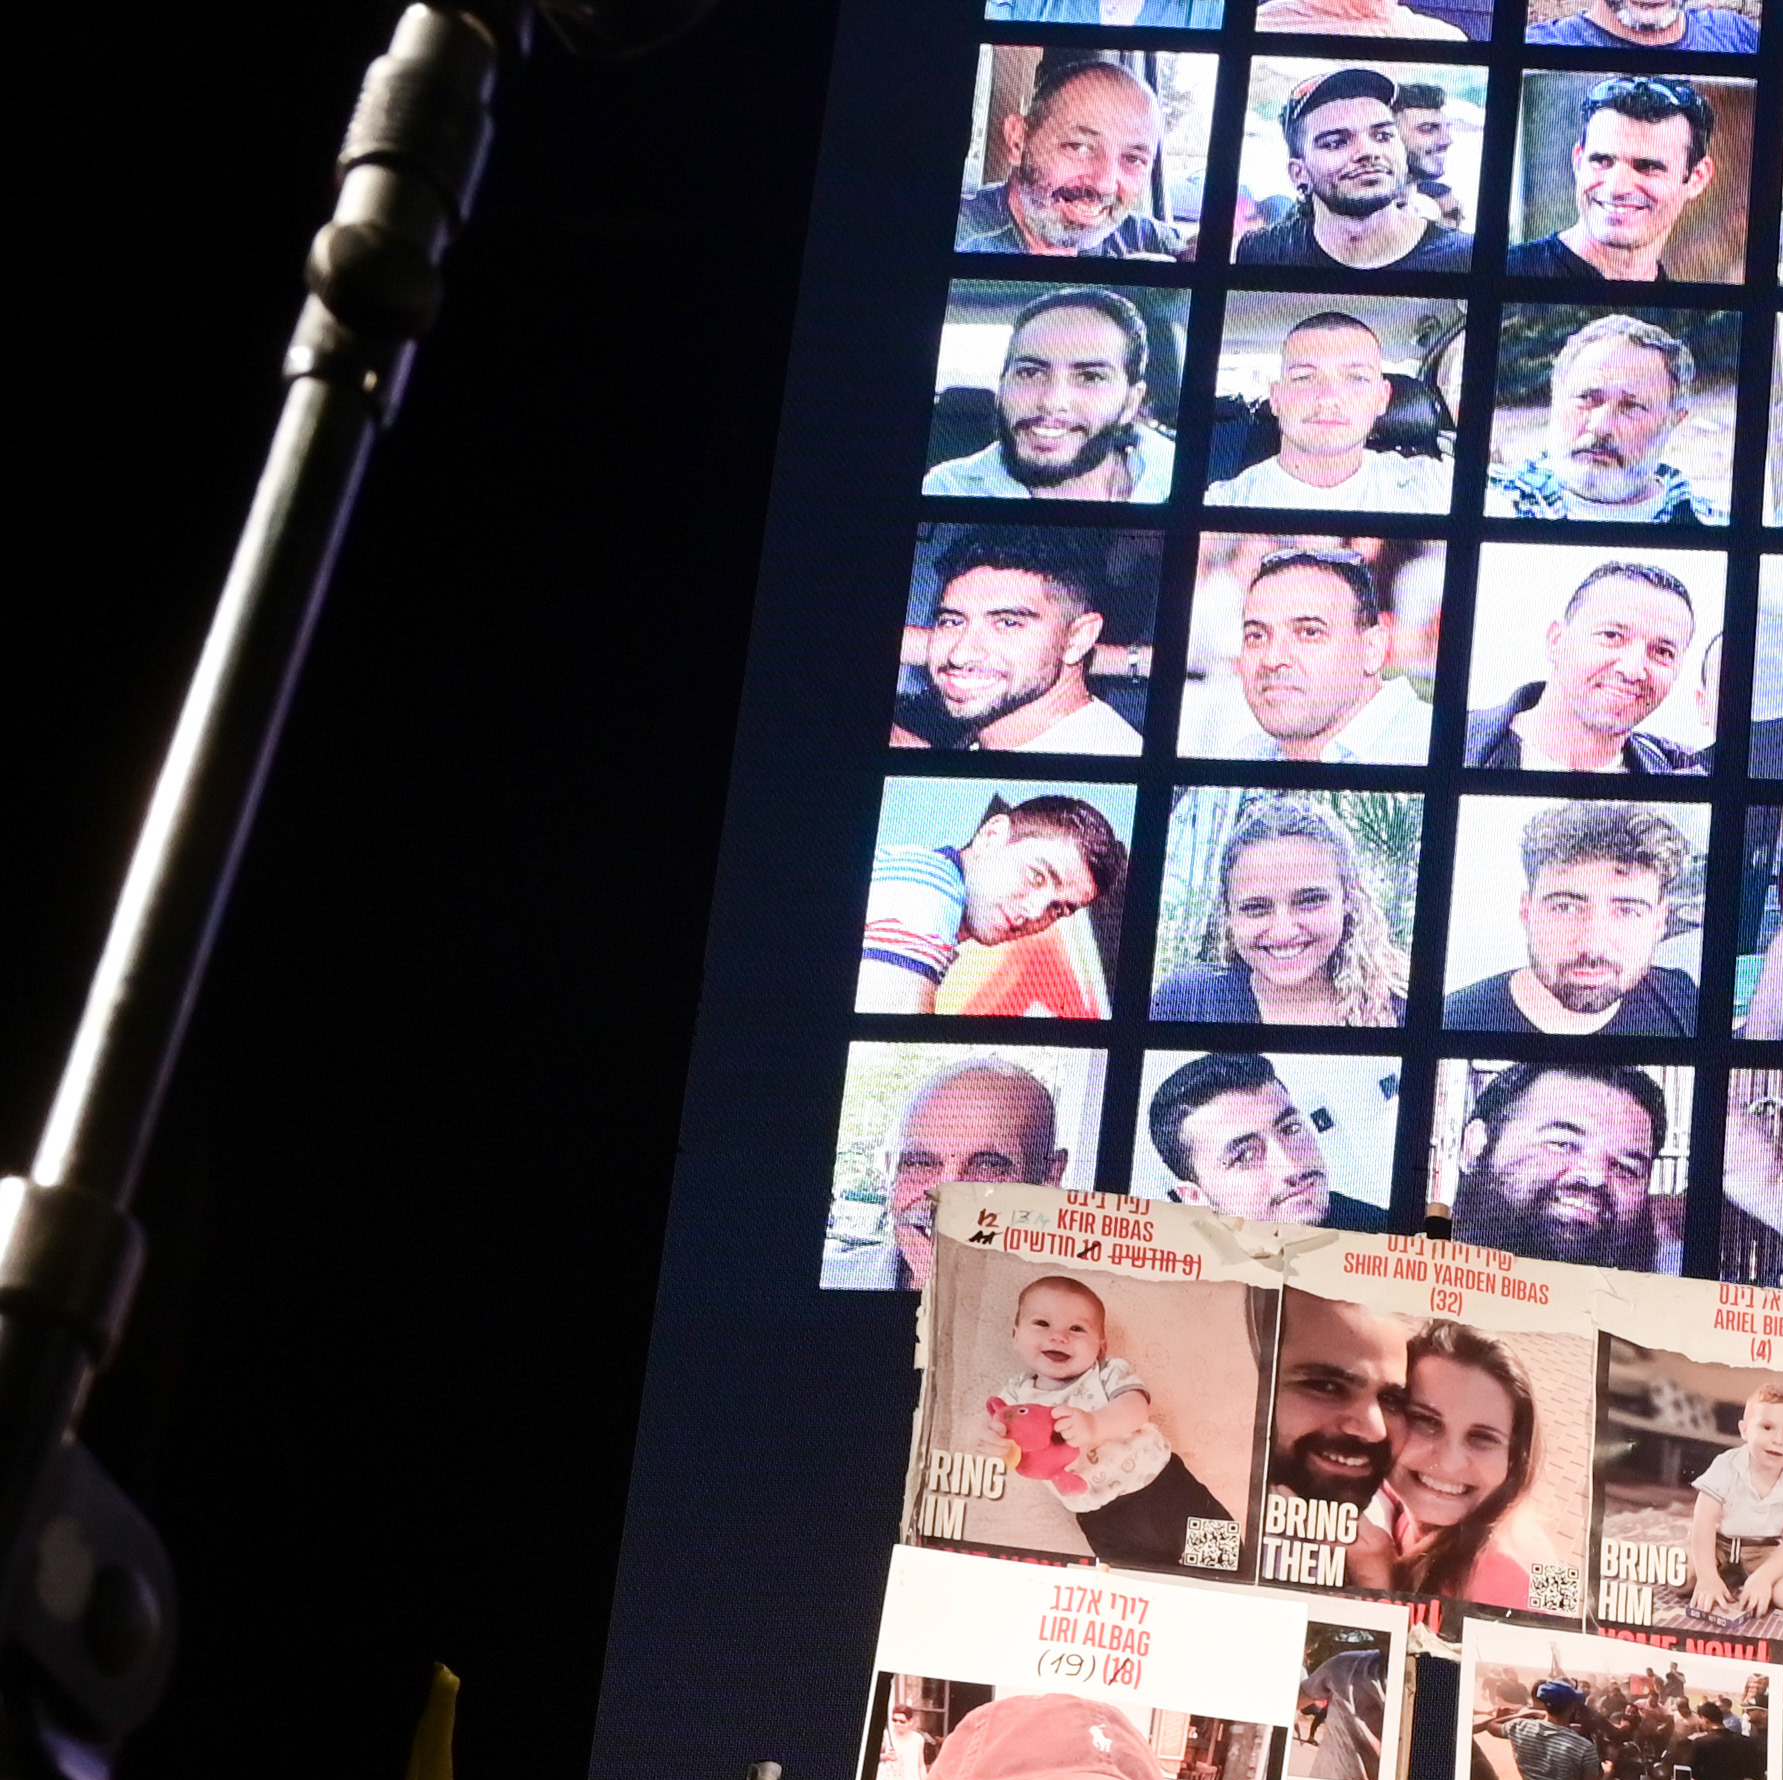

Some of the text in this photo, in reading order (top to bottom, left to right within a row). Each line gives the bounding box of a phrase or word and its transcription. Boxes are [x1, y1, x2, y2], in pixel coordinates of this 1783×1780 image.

[1057, 1208, 1099, 1233] KFIR
[1101, 1214, 1153, 1242] BIBAS
[1344, 1252, 1549, 1305] SHIRI AND YARDEN BIBAS
[1430, 1287, 1463, 1316] (32)
[1714, 1309, 1758, 1334] ARIEL
[1751, 1338, 1772, 1364] (4)
[1262, 1536, 1346, 1589] THEM
[1050, 1584, 1149, 1625] לירי אלבג
[1038, 1615, 1150, 1657] LIRI ALBAG
[1037, 1650, 1096, 1682] (19)
